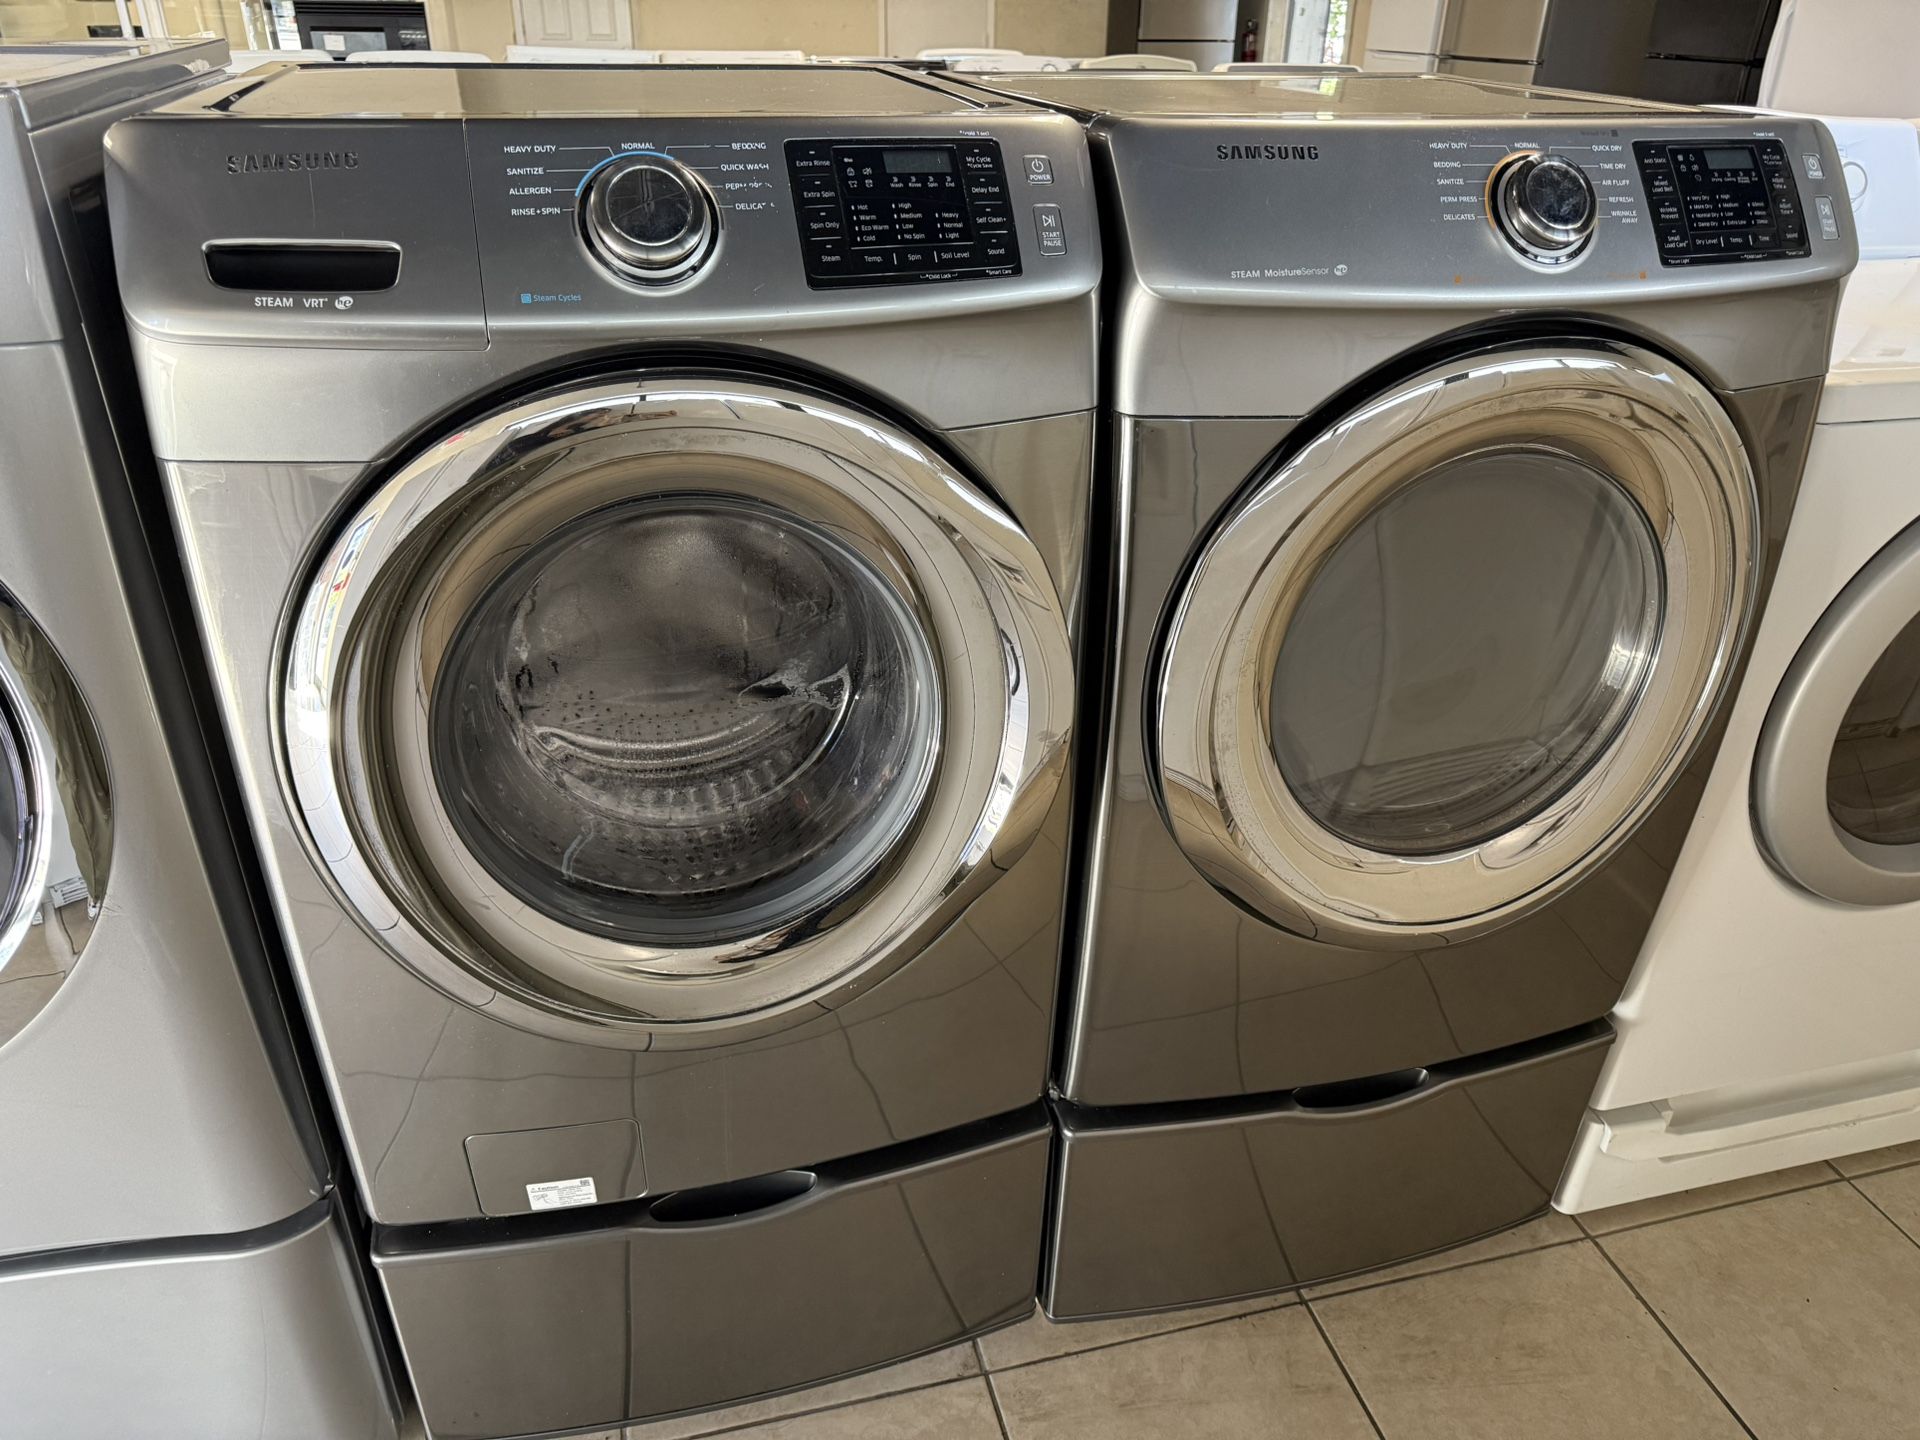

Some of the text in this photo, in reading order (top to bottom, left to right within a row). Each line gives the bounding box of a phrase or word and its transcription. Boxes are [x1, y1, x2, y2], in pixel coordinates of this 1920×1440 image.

[503, 145, 556, 154] HEAVY DUTY
[621, 142, 655, 150] NORMAL
[731, 142, 767, 150] BEDDING
[1216, 144, 1319, 161] SAMSUNG
[226, 151, 359, 175] SAMSUNG
[813, 159, 831, 167] Rinse
[966, 155, 992, 164] My Cycle
[506, 167, 545, 176] SANITIZE
[720, 163, 745, 172] QUICK
[509, 187, 552, 196] ALLERGEN
[821, 190, 836, 198] Spin
[971, 186, 988, 194] Delay
[511, 207, 561, 216] RINSE+SPIN
[976, 216, 988, 224] Self
[1443, 213, 1476, 221] DELICATES
[825, 221, 840, 229] Only
[954, 251, 970, 259] Level
[987, 247, 1005, 255] Sound
[907, 253, 922, 261] Spin
[1231, 269, 1260, 279] STEAM
[1264, 267, 1329, 278] MoistureSensor
[254, 297, 293, 308] STEAM
[533, 294, 582, 303] Steam Cycles
